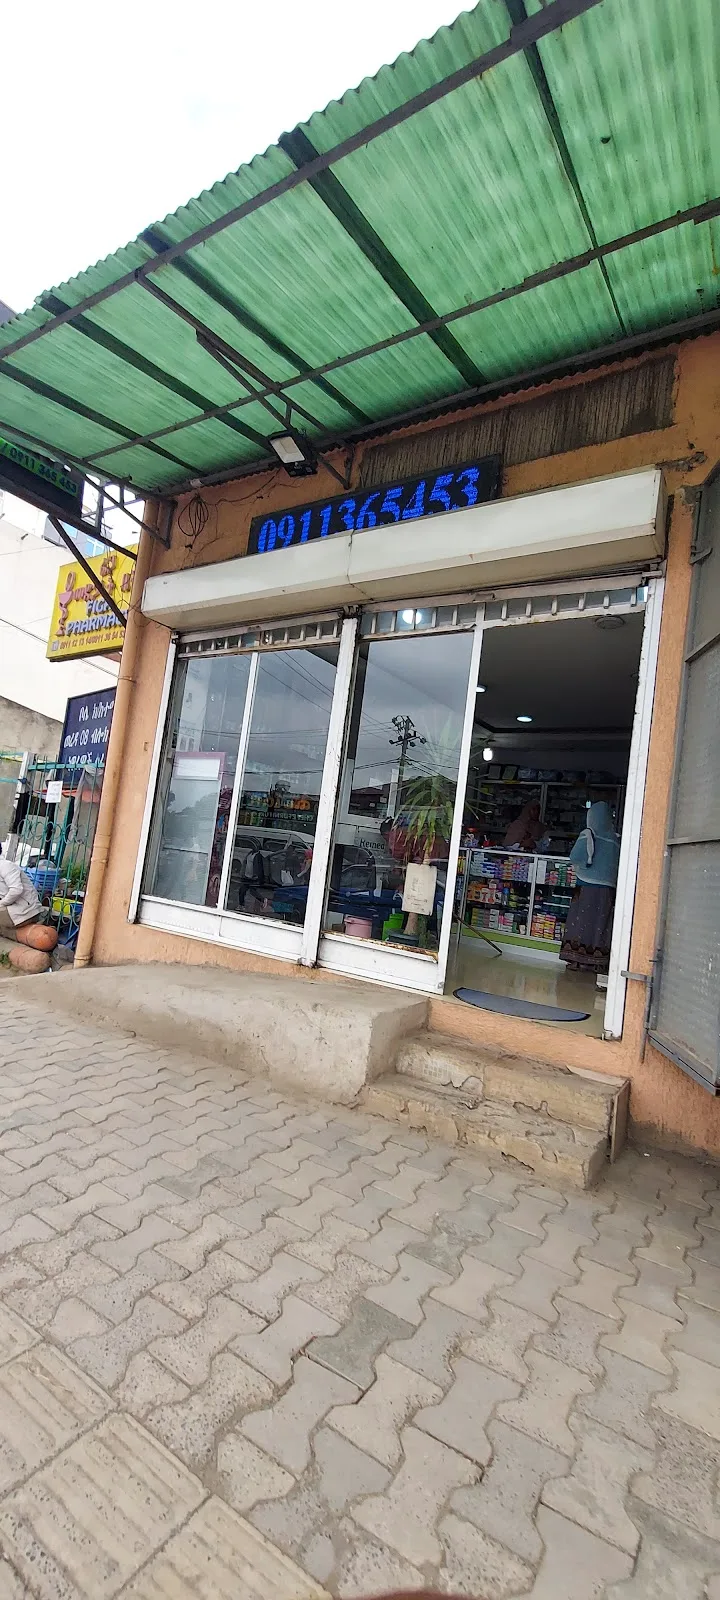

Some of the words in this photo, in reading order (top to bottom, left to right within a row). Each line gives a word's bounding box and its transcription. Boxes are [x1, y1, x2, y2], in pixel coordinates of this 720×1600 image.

[9, 447, 35, 470] 0911
[257, 466, 480, 553] 0911365453
[63, 731, 79, 748] ወረዳ
[79, 728, 90, 746] 08
